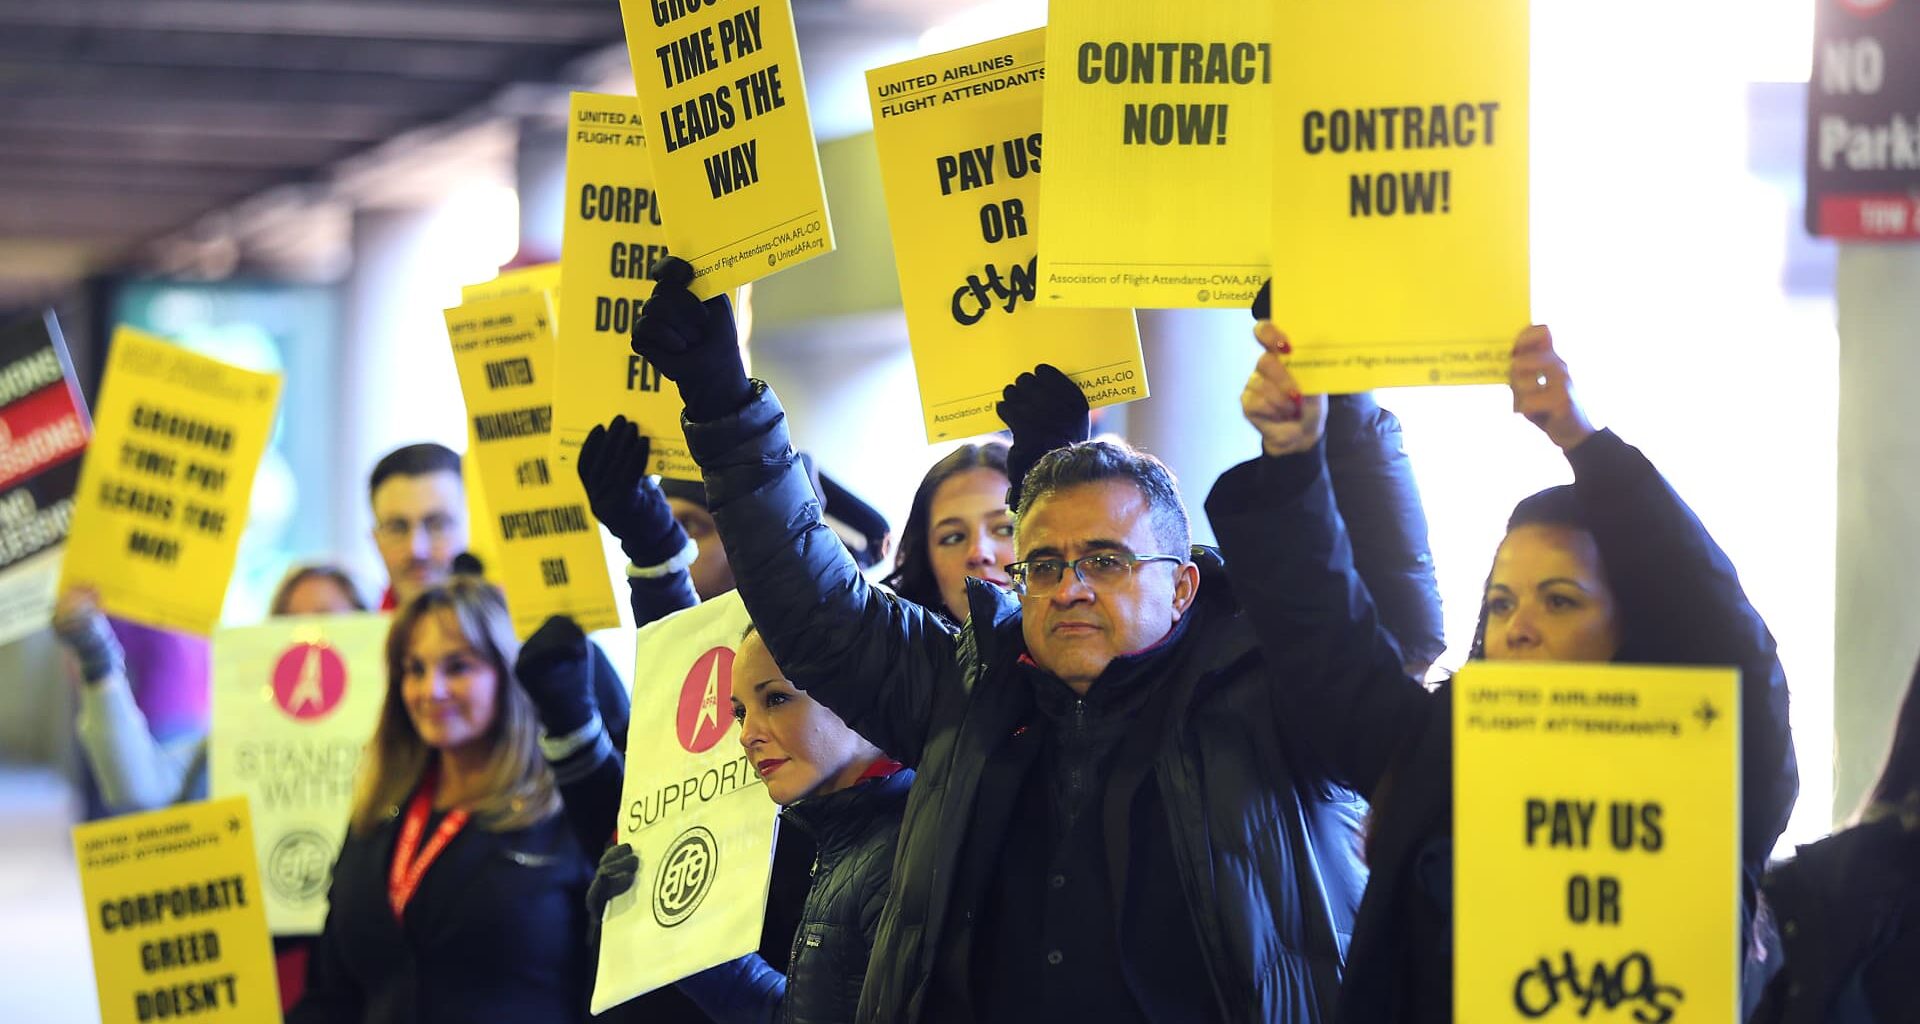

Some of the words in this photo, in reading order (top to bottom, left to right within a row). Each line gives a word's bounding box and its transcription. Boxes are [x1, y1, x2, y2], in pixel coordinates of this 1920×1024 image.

[656, 27, 718, 88] TIME
[718, 6, 762, 64] PAY
[1077, 42, 1272, 84] CONTRACT
[1821, 37, 1885, 95] NO
[878, 74, 937, 97] UNITED
[943, 55, 1014, 82] AIRLINES
[577, 111, 626, 124] UNITED
[660, 86, 735, 153] LEADS
[735, 64, 785, 121] THE
[882, 95, 937, 118] FLIGHT
[1123, 103, 1229, 146] NOW!
[1303, 102, 1500, 155] CONTRACT
[577, 131, 620, 144] FLIGHT
[1818, 113, 1920, 170] Park
[704, 139, 758, 199] WAY
[936, 145, 995, 196] PAY
[1003, 133, 1043, 179] US
[1350, 170, 1451, 217] NOW!
[980, 198, 1028, 243] OR
[611, 242, 668, 281] GRE
[721, 255, 738, 268] Flight
[777, 238, 824, 261] UnitedAFA.org
[1049, 273, 1106, 285] Association
[1110, 273, 1120, 284] of
[1123, 274, 1149, 287] Flight
[1212, 290, 1256, 301] UnitedA
[934, 406, 982, 424] Association
[983, 402, 994, 414] of
[628, 756, 761, 833] SUPPORT
[1524, 797, 1597, 850] PAY
[1610, 801, 1664, 854] US
[99, 874, 248, 934] CORPORATE
[1566, 874, 1622, 927] OR
[140, 929, 221, 975] GREED
[134, 973, 238, 1023] DOESN'T
[1513, 950, 1685, 1024] CHAOS
